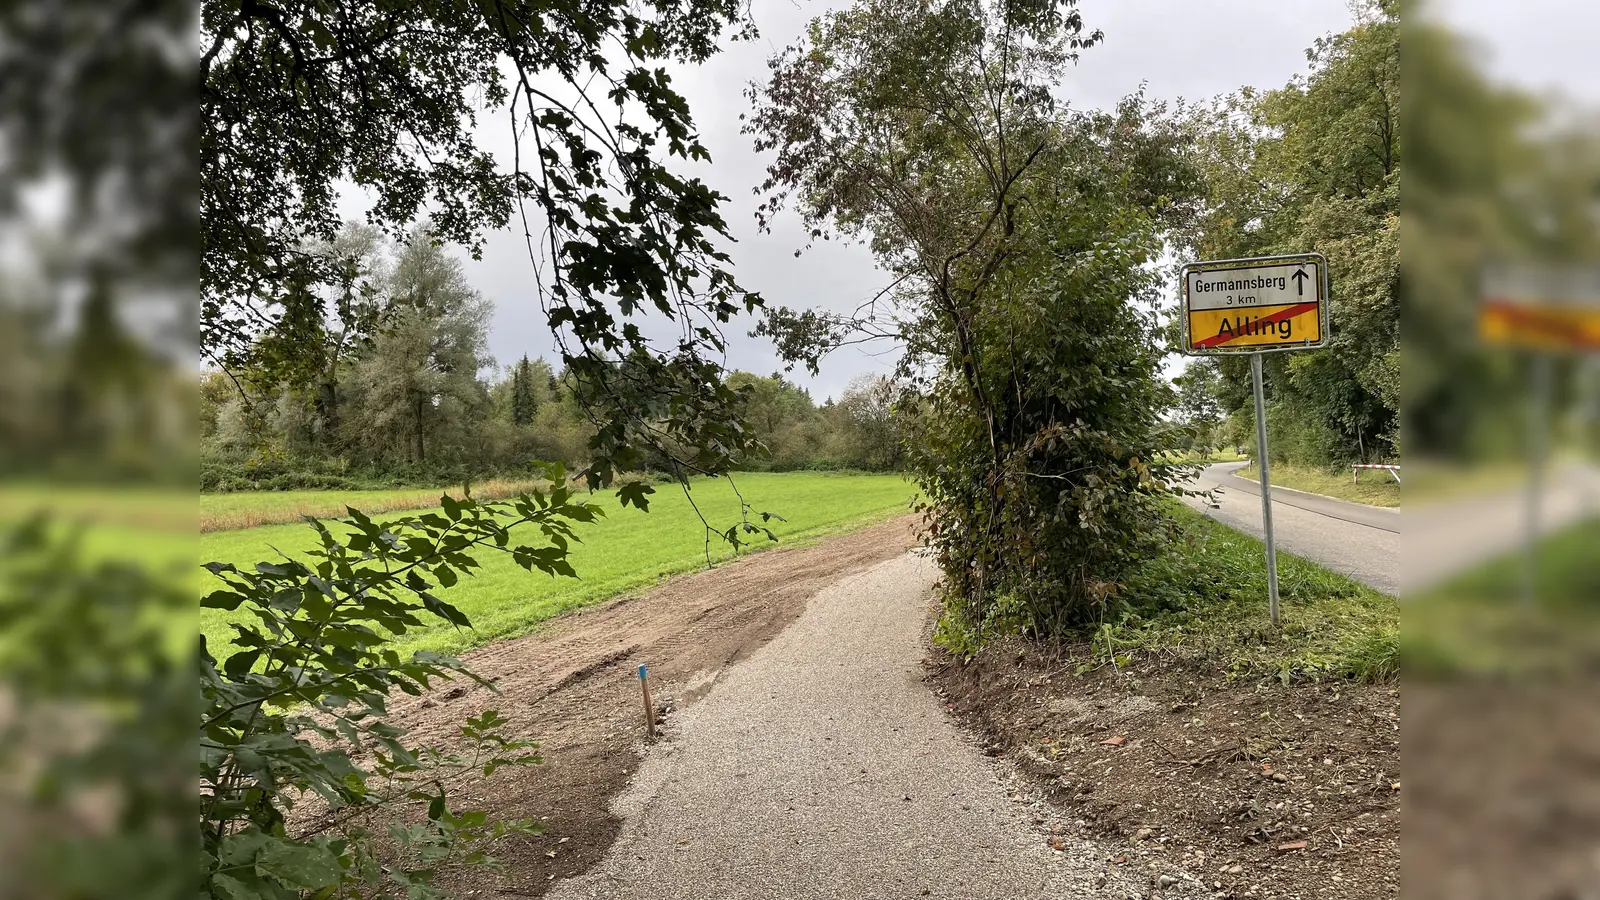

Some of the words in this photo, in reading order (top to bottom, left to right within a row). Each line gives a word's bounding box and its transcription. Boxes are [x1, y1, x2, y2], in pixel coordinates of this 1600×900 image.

[1195, 275, 1286, 293] Germannsberg
[1226, 295, 1233, 305] 3
[1238, 294, 1256, 304] km
[1217, 315, 1292, 339] Alling
